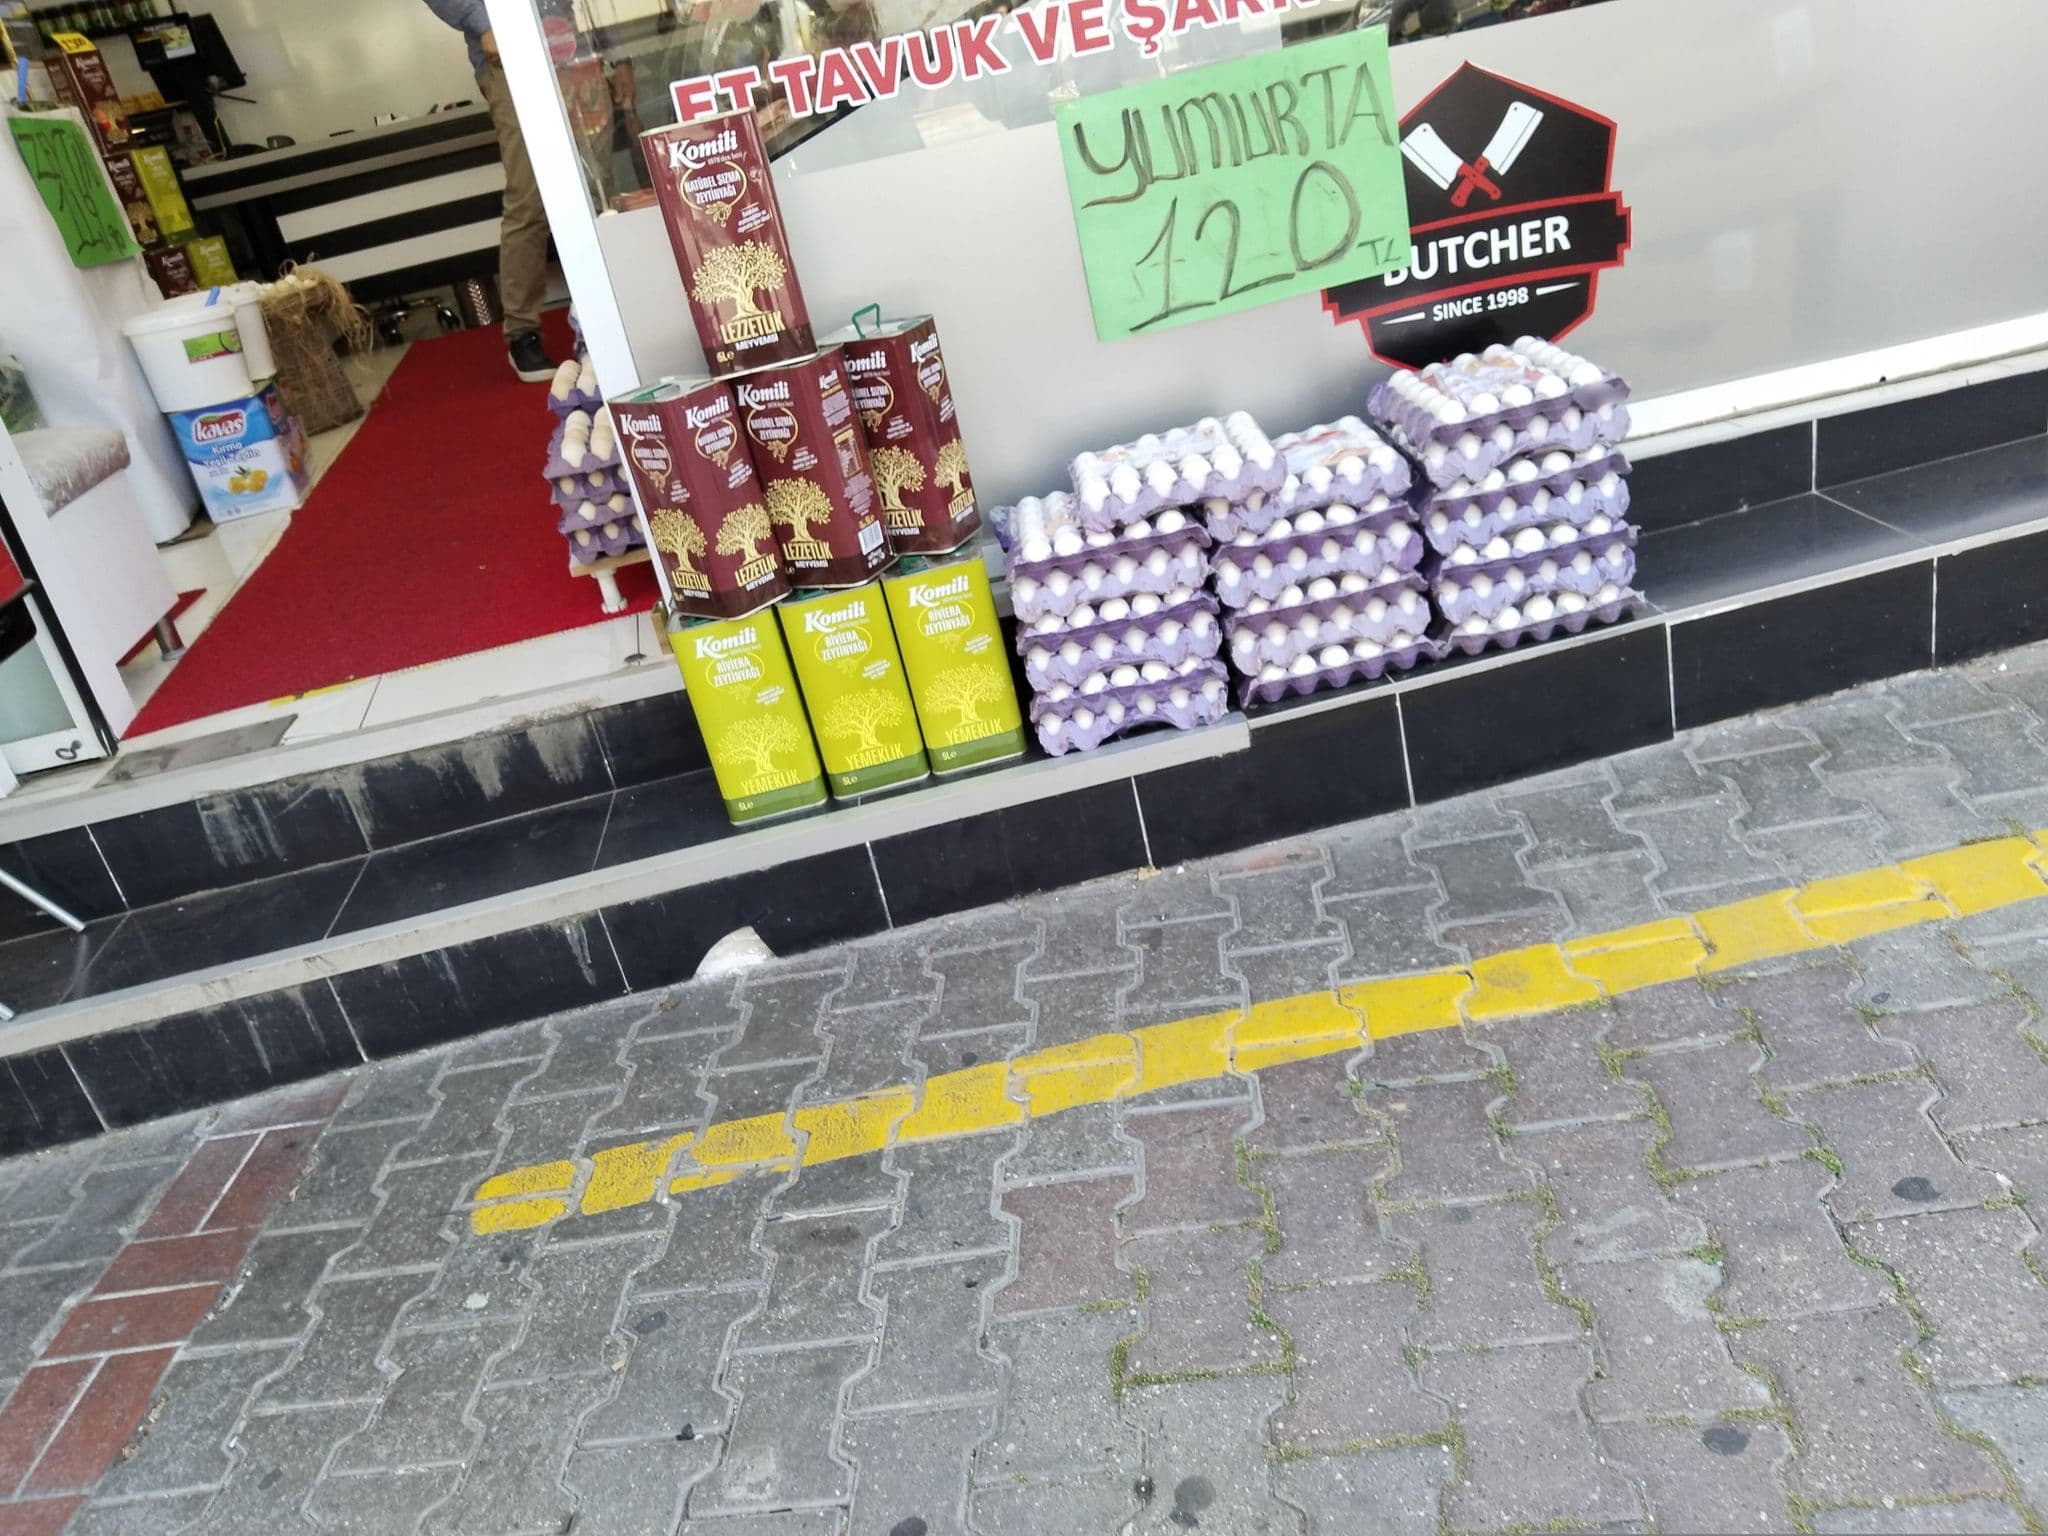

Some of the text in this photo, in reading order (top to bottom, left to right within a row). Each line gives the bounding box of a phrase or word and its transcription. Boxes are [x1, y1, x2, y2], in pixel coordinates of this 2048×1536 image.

[771, 17, 1009, 116] TAVUK
[1016, 0, 1112, 63] VE
[668, 130, 738, 169] Komili
[1073, 62, 1394, 210] YUMURTA
[1129, 160, 1362, 331] 120
[1433, 287, 1529, 321] SINCE 1998
[736, 381, 790, 410] Komili
[620, 414, 662, 440] Komili
[685, 396, 730, 429] Komili
[908, 575, 969, 608] Komili
[804, 600, 865, 633] Komili
[694, 626, 756, 659] Komili
